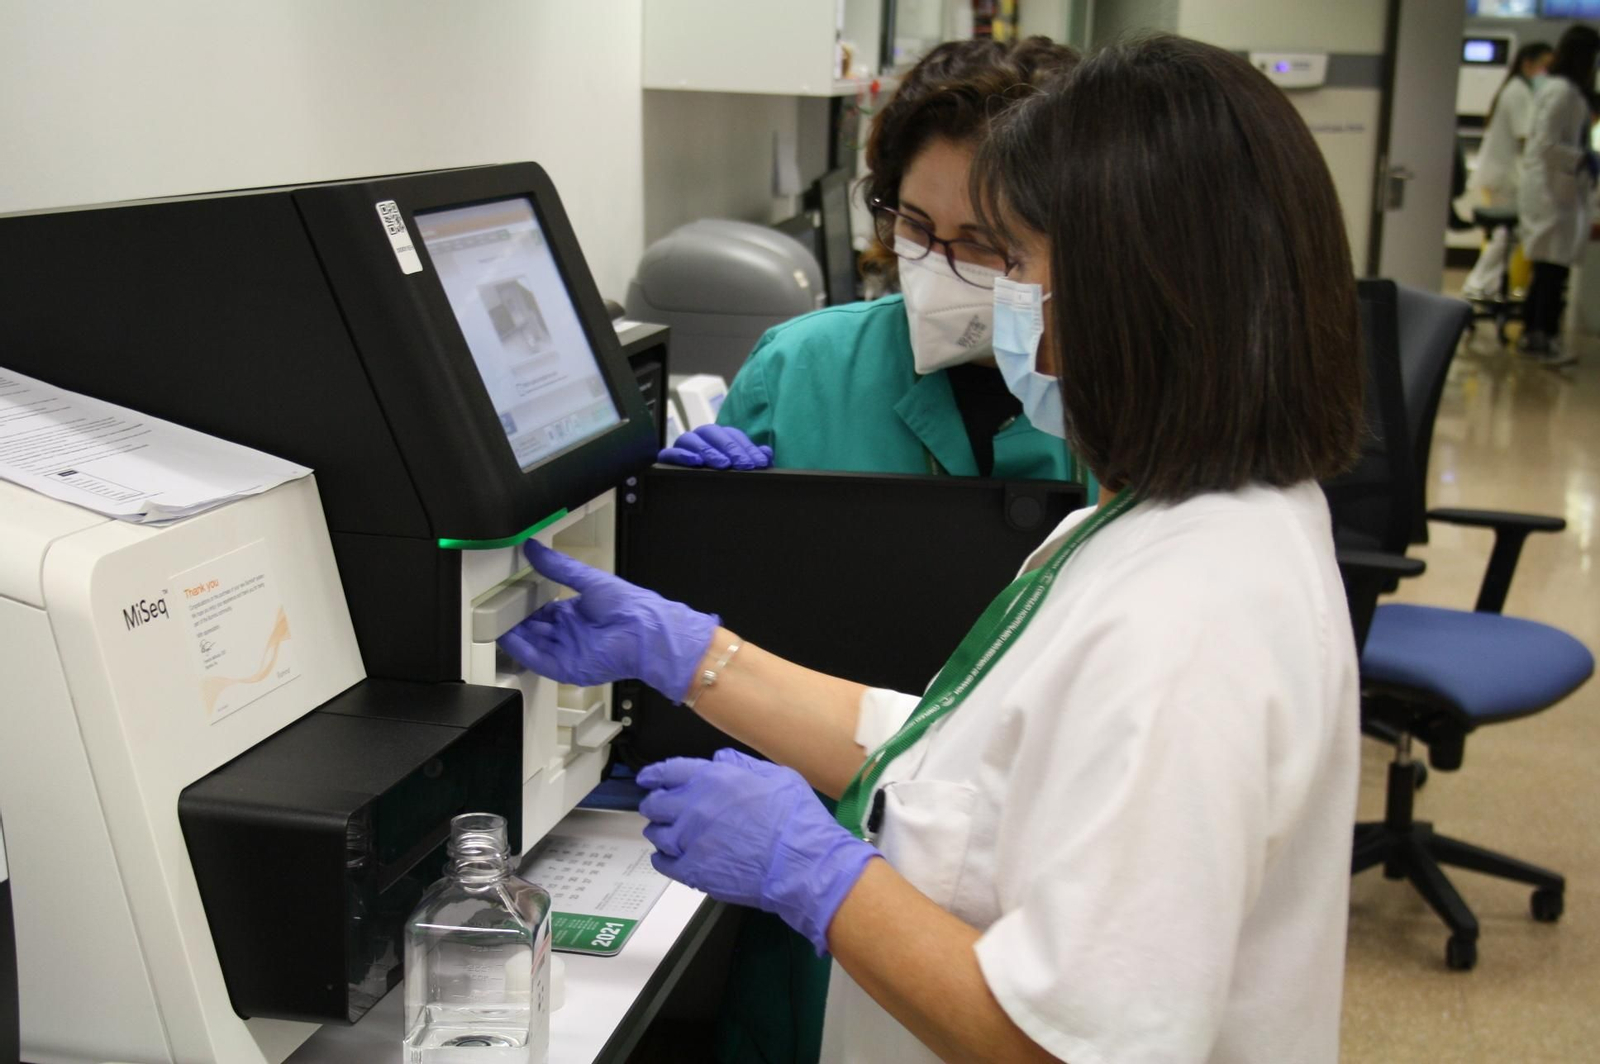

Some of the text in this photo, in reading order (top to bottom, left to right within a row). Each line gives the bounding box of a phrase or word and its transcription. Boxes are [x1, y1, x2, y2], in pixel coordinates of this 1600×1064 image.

[183, 584, 206, 599] Thank
[207, 579, 219, 592] you
[123, 598, 169, 631] MiSeq
[591, 922, 624, 947] 2021
